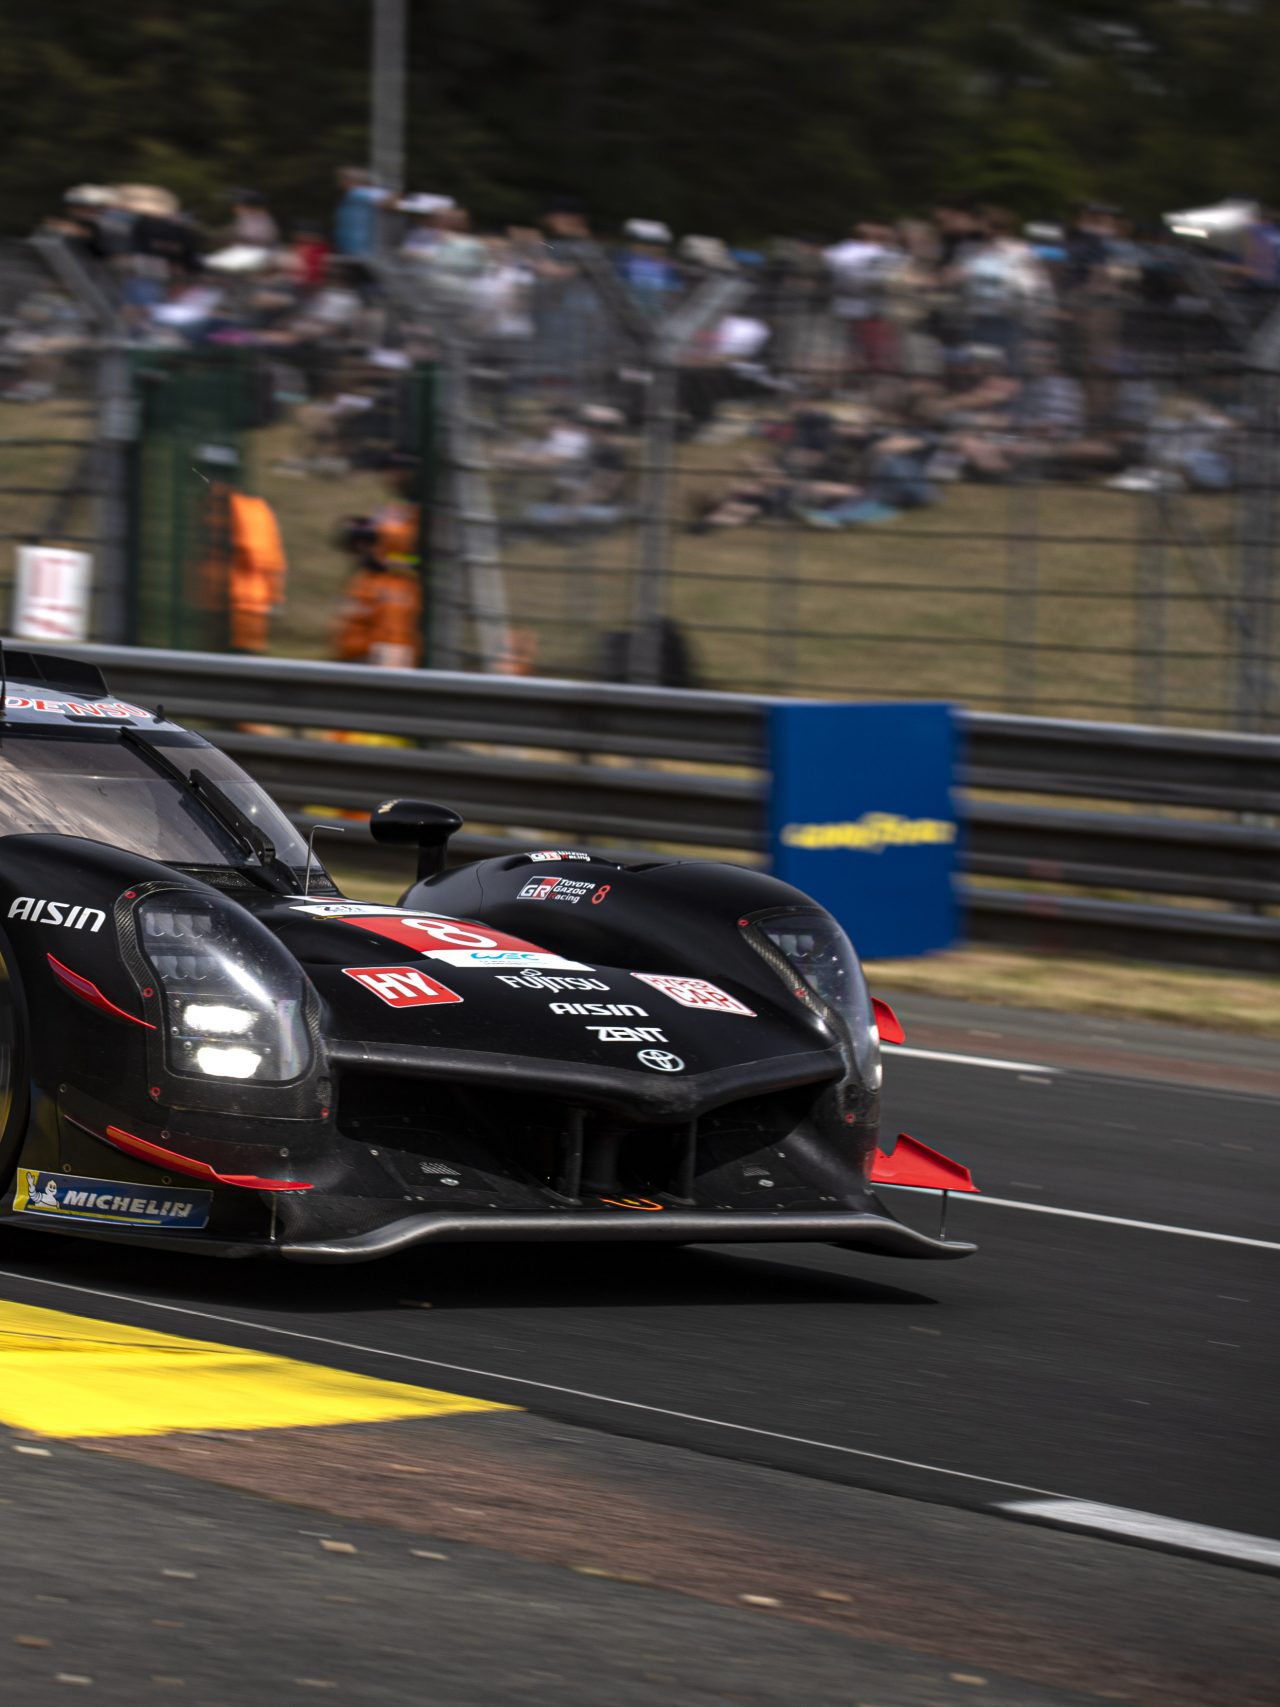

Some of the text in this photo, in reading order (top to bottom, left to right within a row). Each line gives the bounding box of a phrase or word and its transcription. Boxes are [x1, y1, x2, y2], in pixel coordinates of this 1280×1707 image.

[553, 886, 587, 895] GAZOO
[560, 879, 596, 890] TOYOTA
[520, 884, 611, 905] GR 8
[548, 891, 580, 904] Racing
[401, 918, 498, 948] 8
[356, 972, 439, 999] HY
[494, 974, 610, 993] FUJITSU
[664, 986, 744, 1011] CAR
[549, 1002, 649, 1017] AISIN
[585, 1026, 669, 1043] ZENT
[63, 1190, 192, 1218] MICHELIN
